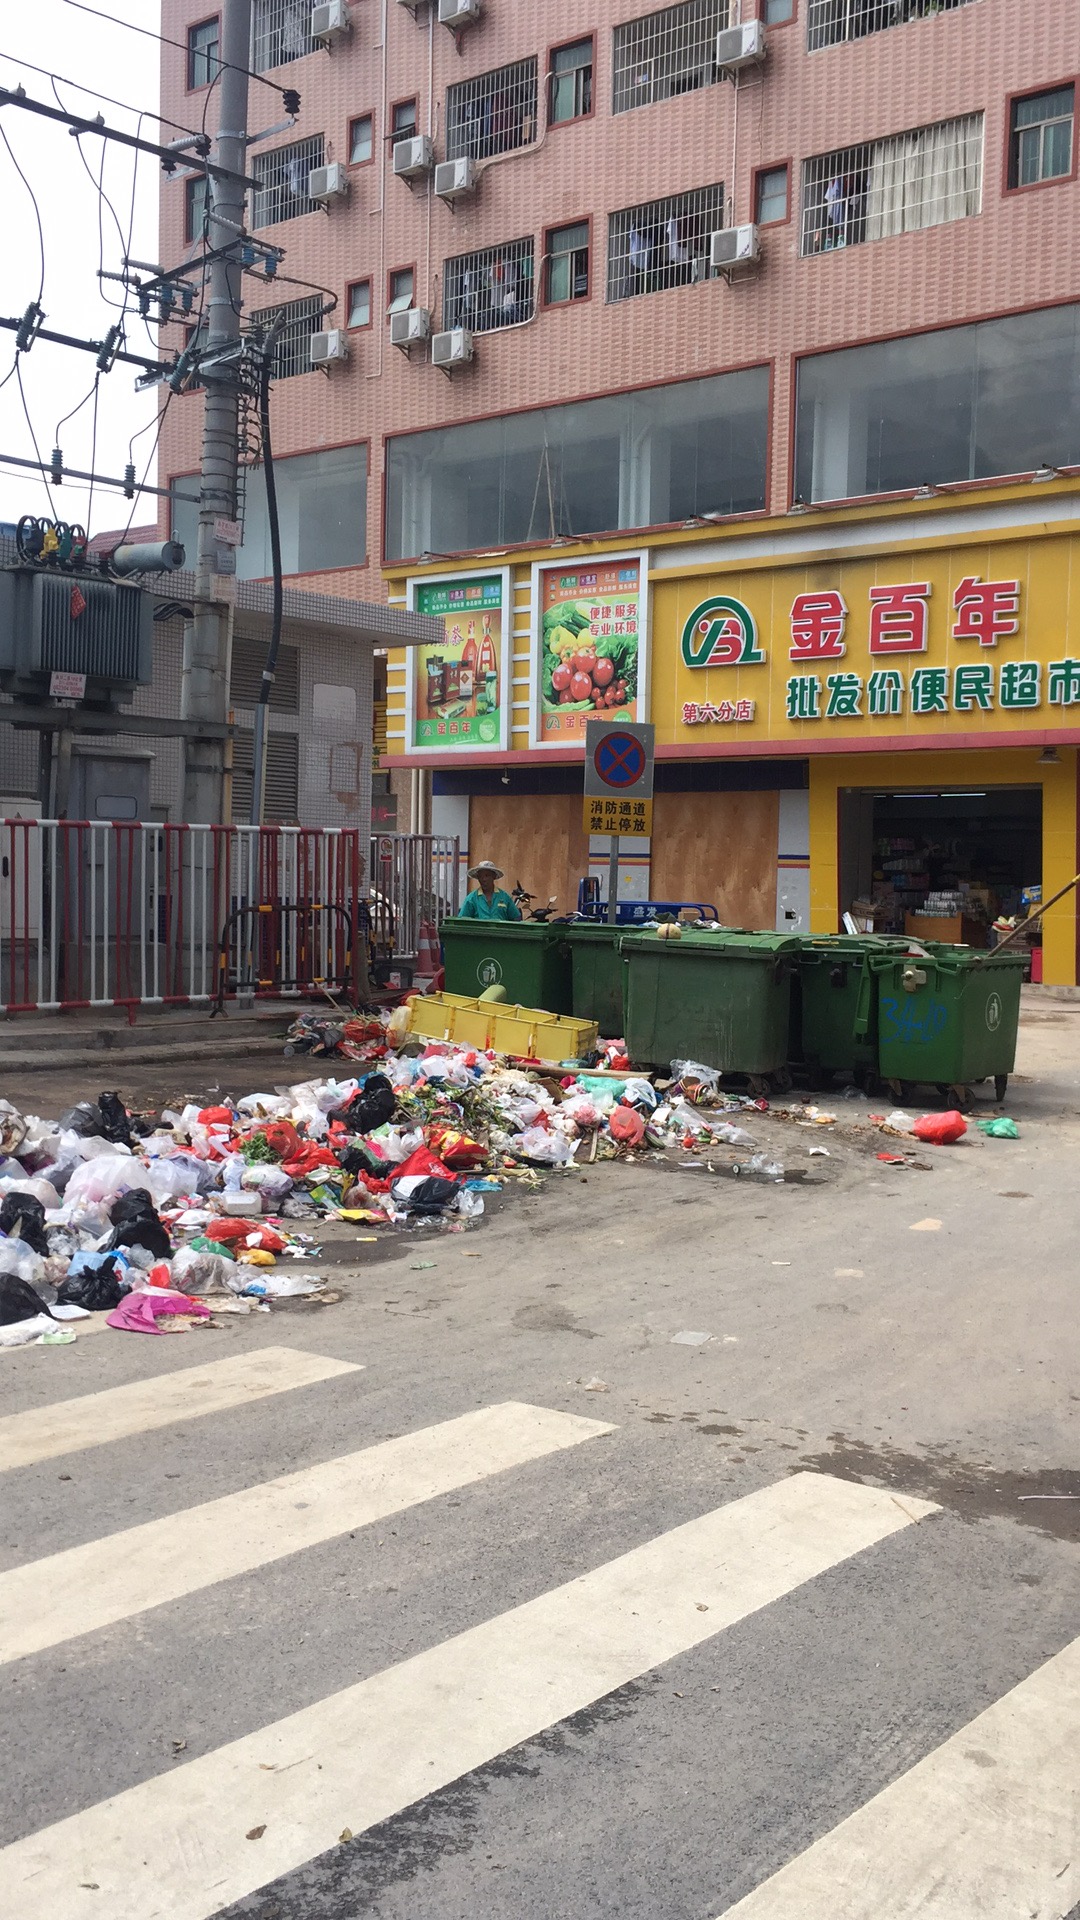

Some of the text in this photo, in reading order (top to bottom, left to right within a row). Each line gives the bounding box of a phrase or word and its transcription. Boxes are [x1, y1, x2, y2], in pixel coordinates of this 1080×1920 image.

[789, 577, 1020, 660] 金百年
[787, 659, 1080, 719] 批发价便民超市
[682, 700, 755, 724] 第六分店
[437, 720, 471, 735] 金百年
[590, 800, 646, 816] 消防通道
[590, 816, 646, 832] 禁止停放
